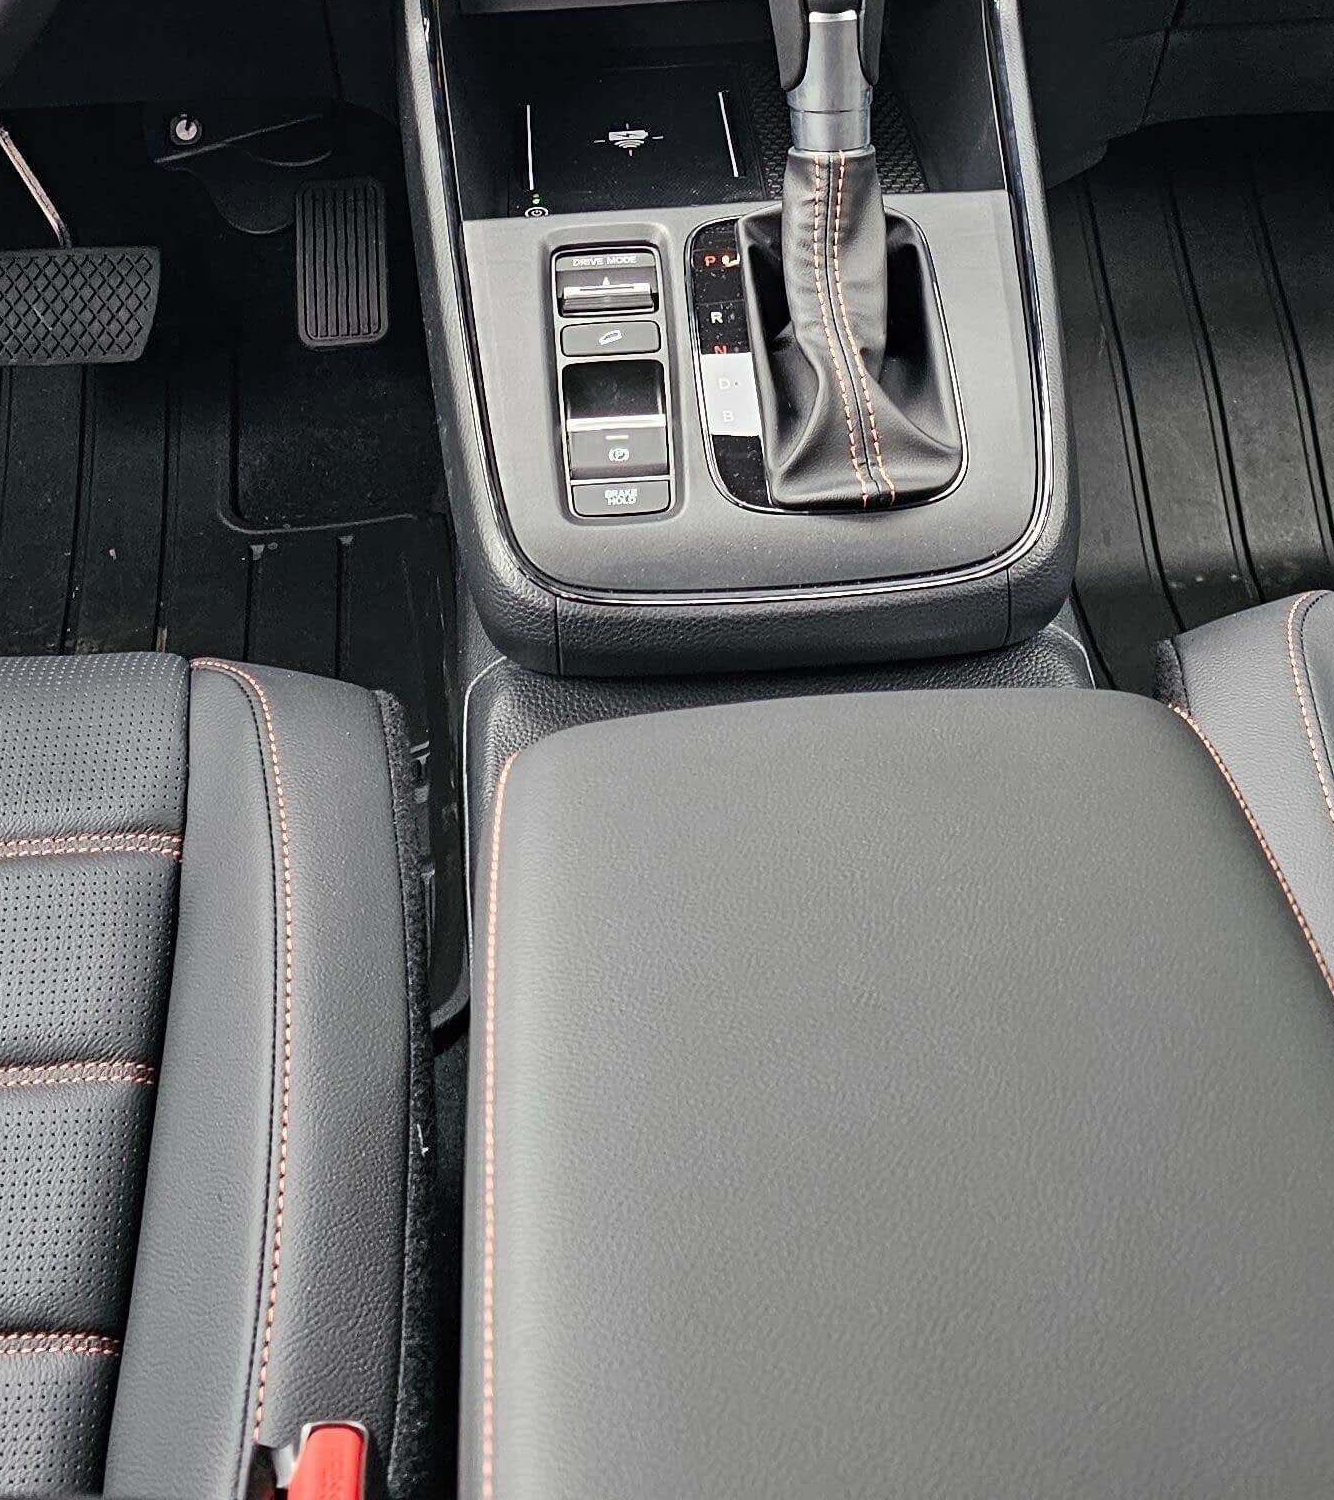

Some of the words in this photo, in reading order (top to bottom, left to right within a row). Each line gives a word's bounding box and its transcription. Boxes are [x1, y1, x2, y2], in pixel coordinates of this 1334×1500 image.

[572, 256, 603, 267] DRIVE
[606, 254, 637, 265] MODE
[704, 256, 716, 267] P
[710, 311, 723, 324] R
[714, 345, 727, 354] N
[719, 379, 730, 390] D
[722, 411, 735, 423] B
[604, 488, 638, 500] BRAKE
[607, 495, 638, 506] HOLD
